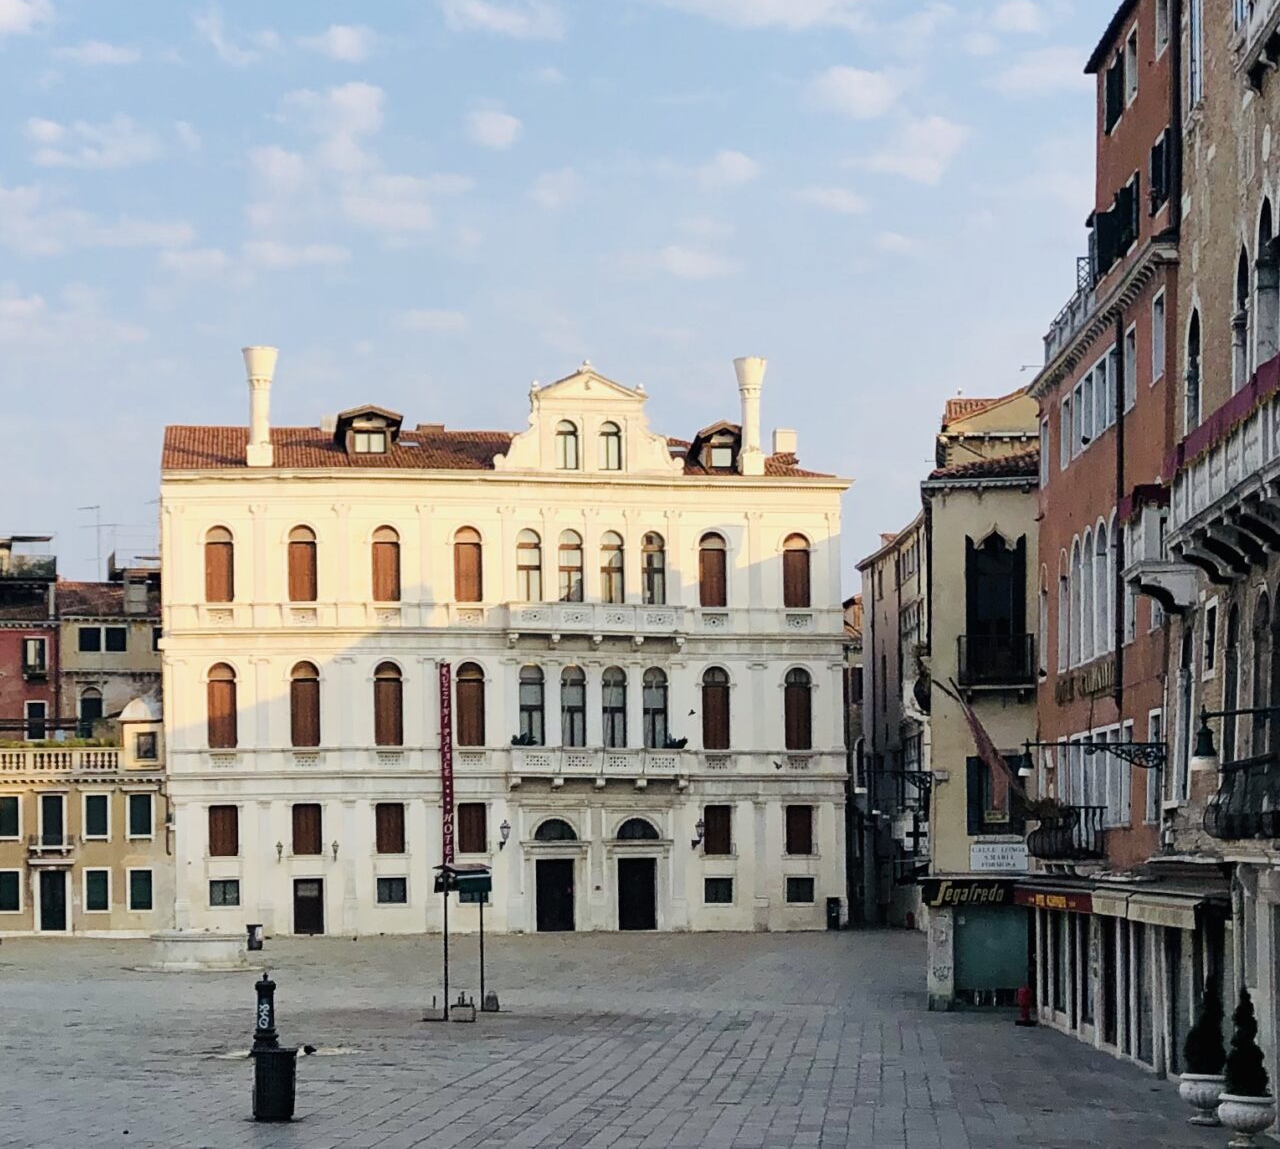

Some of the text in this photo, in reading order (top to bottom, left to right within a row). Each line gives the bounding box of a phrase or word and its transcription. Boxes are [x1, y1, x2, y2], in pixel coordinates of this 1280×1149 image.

[441, 665, 454, 865] RUZZINI PALACE HOTEL
[930, 881, 1005, 906] Segafredo
